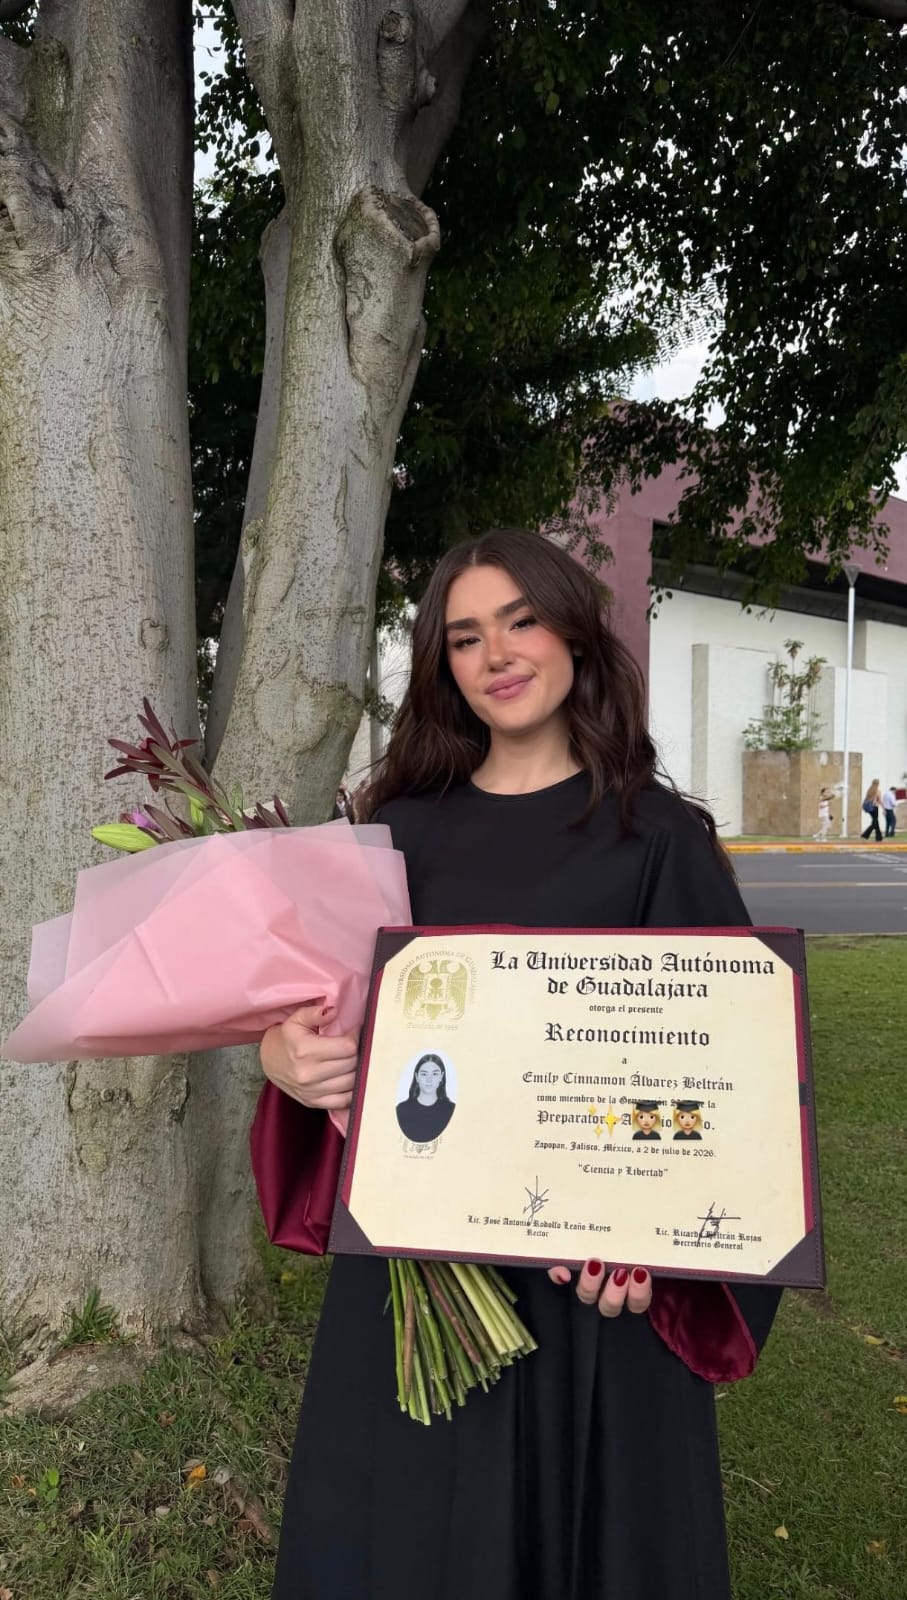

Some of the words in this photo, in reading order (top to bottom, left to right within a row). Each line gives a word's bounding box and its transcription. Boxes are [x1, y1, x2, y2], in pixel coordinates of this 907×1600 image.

[491, 951, 518, 969] La
[527, 951, 652, 971] Universidad
[661, 952, 775, 974] Autónoma
[548, 977, 568, 994] de
[576, 976, 707, 1000] Guadalajara
[588, 1004, 616, 1014] otorga
[618, 1004, 626, 1012] el
[628, 1006, 664, 1014] presente
[544, 1023, 709, 1046] Reconocimiento
[523, 1072, 558, 1084] Emily
[563, 1072, 625, 1085] Cinnamon
[631, 1071, 678, 1088] Álvarez
[683, 1077, 733, 1091] Beltrán
[560, 1094, 594, 1102] miembro
[596, 1096, 606, 1104] de
[608, 1096, 616, 1104] la
[708, 1100, 716, 1108] la
[536, 1110, 616, 1127] Preparator
[602, 1144, 634, 1154] México,
[642, 1146, 650, 1154] 2
[650, 1146, 660, 1154] de
[662, 1146, 680, 1156] julio
[682, 1148, 690, 1156] de
[618, 1168, 622, 1176] y
[526, 1228, 550, 1238] Rector
